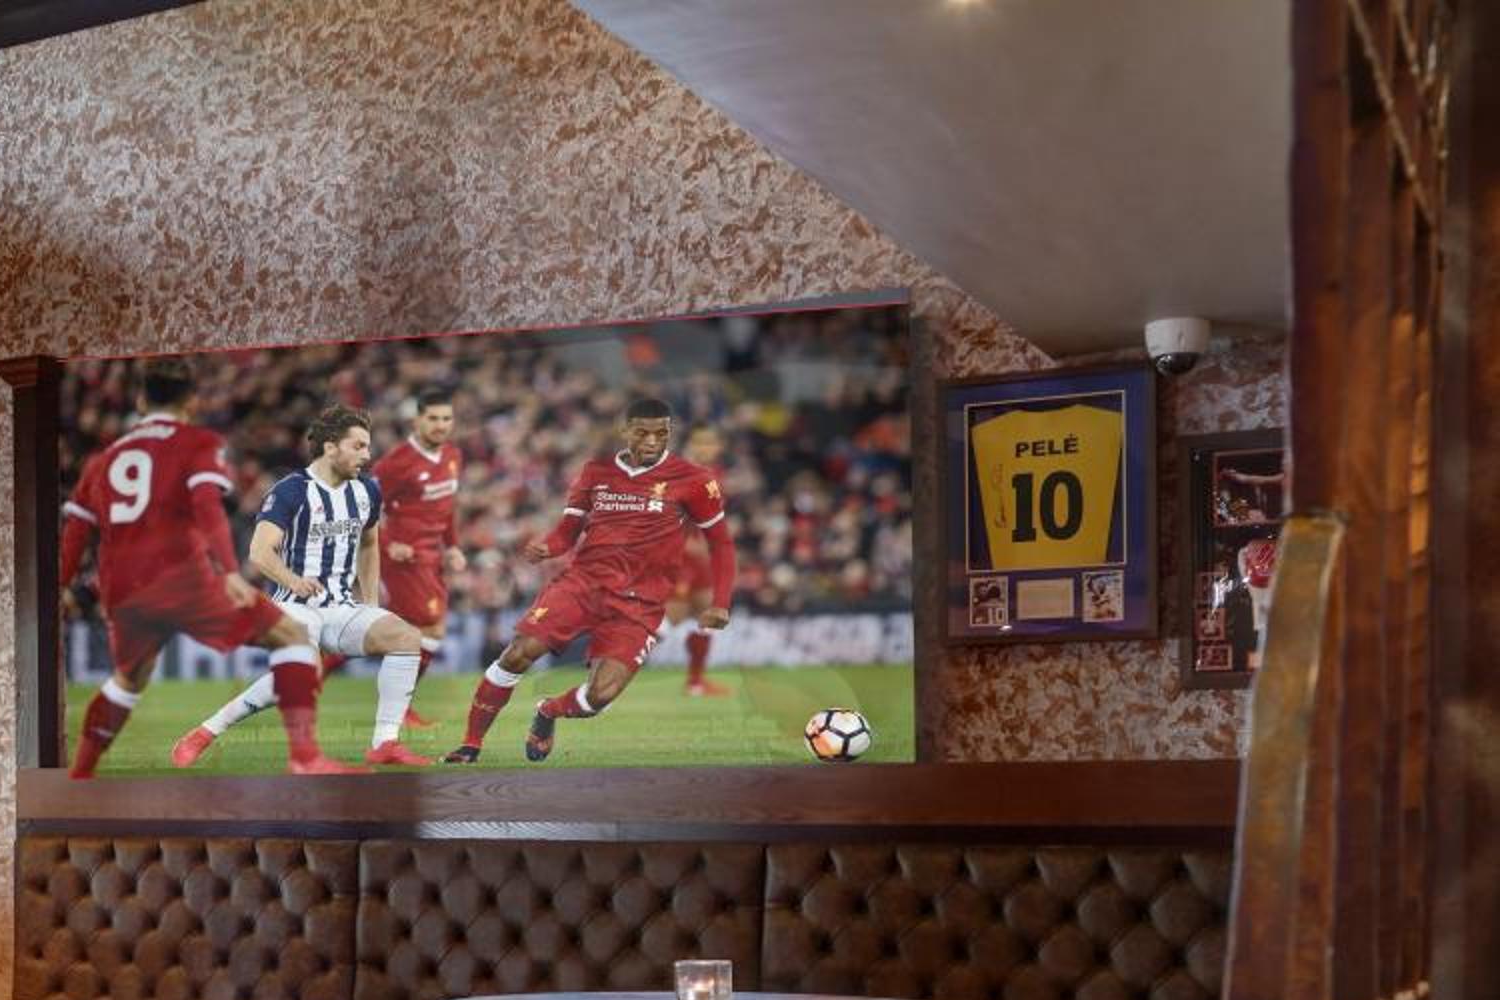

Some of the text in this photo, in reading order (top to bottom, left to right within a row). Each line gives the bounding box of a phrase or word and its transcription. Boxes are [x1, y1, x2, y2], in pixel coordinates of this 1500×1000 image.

[1015, 433, 1078, 458] PELÉ
[108, 450, 152, 523] 9
[1011, 470, 1083, 542] 10
